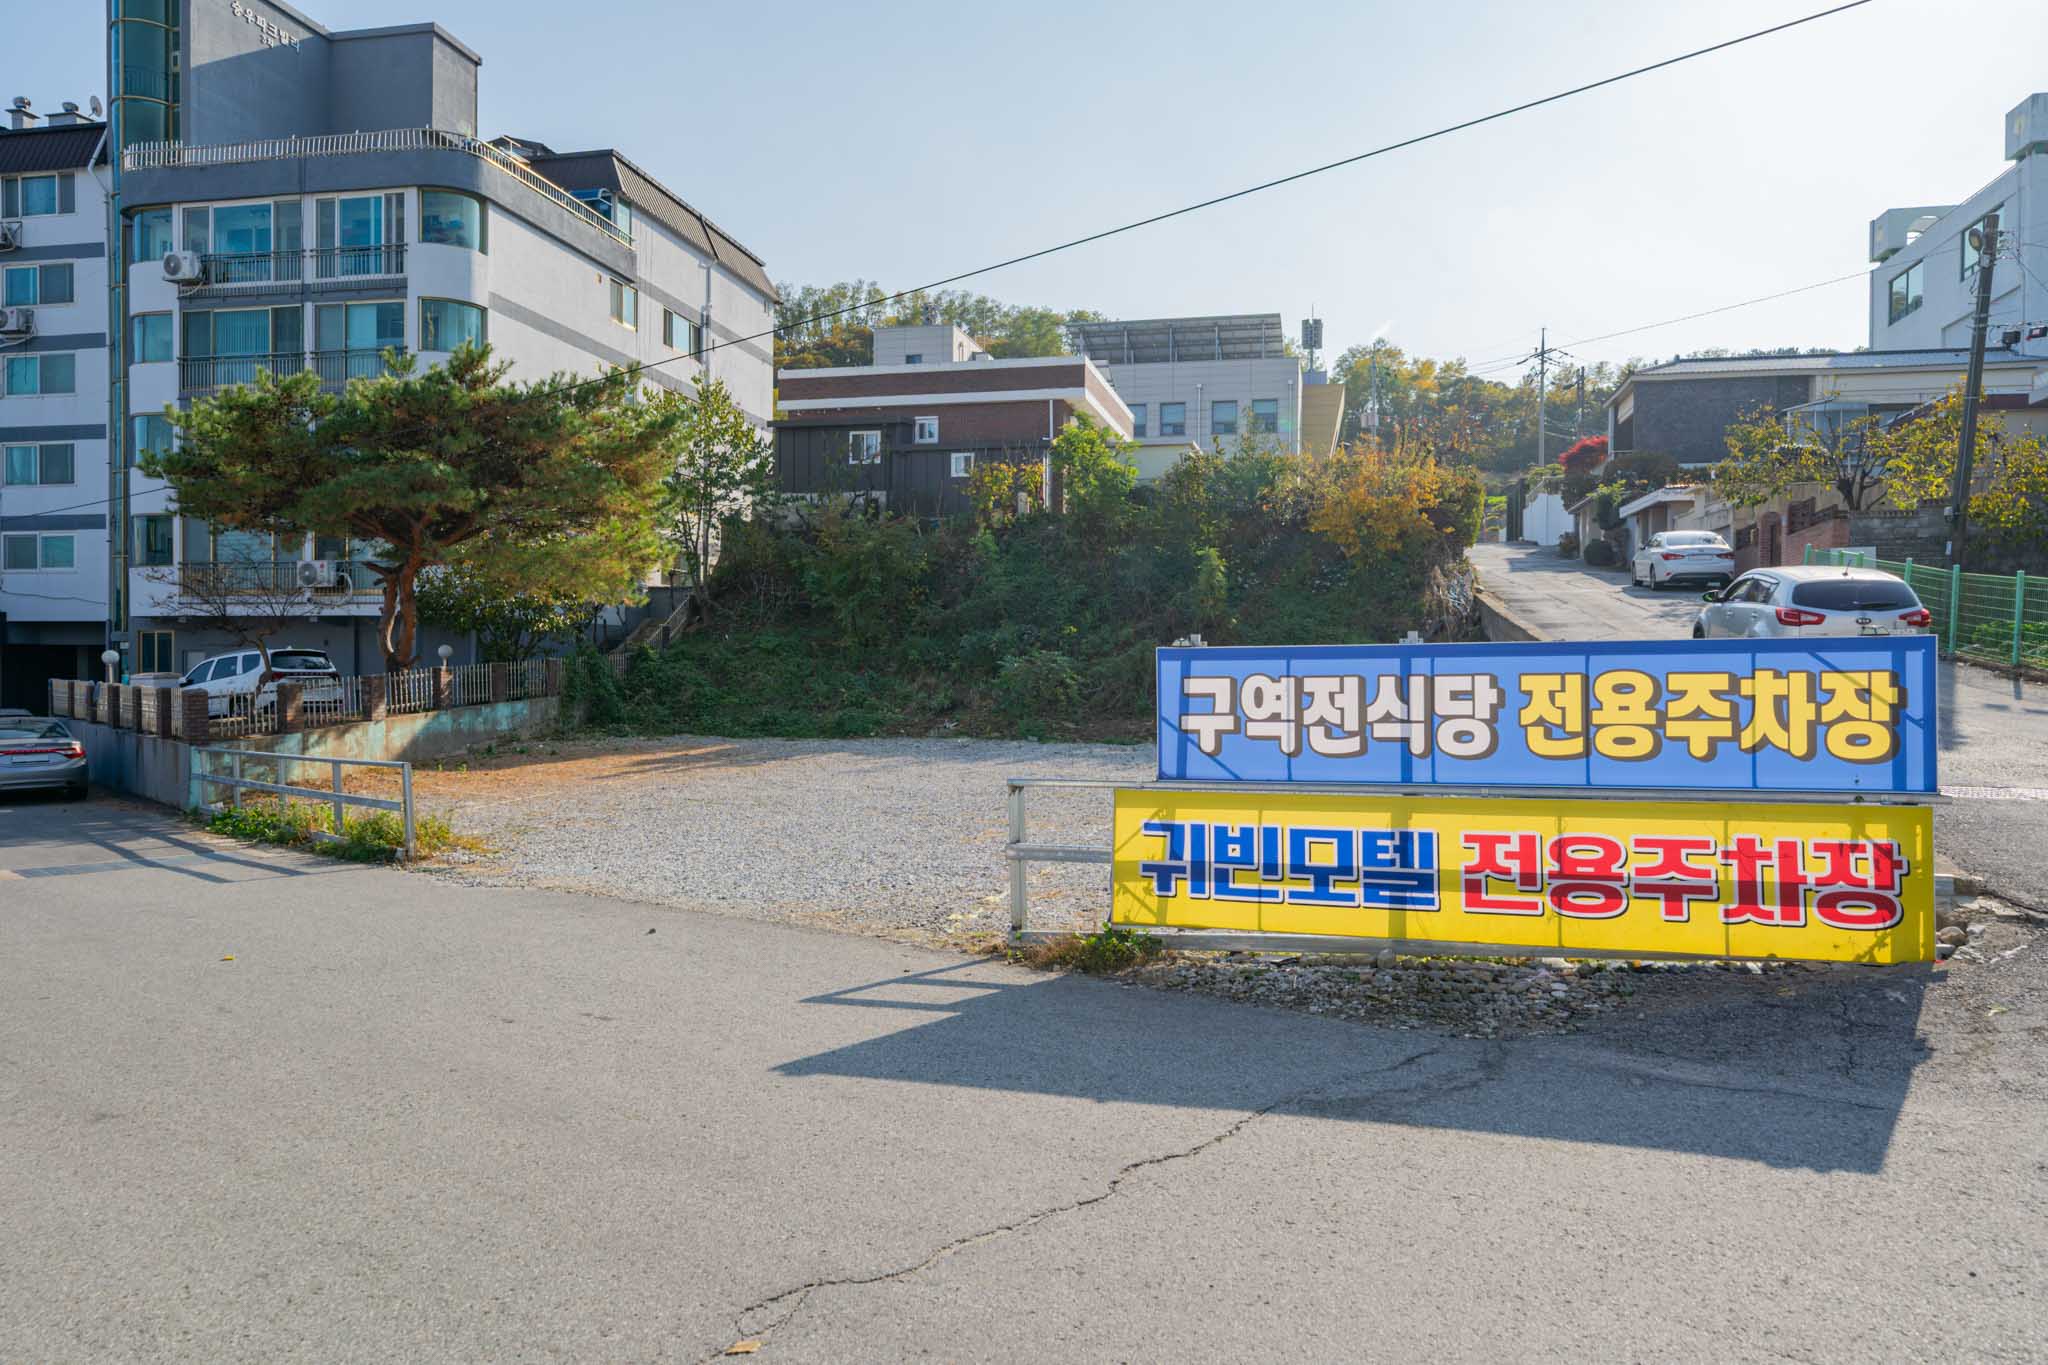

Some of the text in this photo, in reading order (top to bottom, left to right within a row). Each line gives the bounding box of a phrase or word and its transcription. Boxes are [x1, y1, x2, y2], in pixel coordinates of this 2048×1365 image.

[1180, 668, 1907, 764] 구역전식당 전용주차장
[1139, 820, 1909, 931] 귀빈모텔 전용주차장
